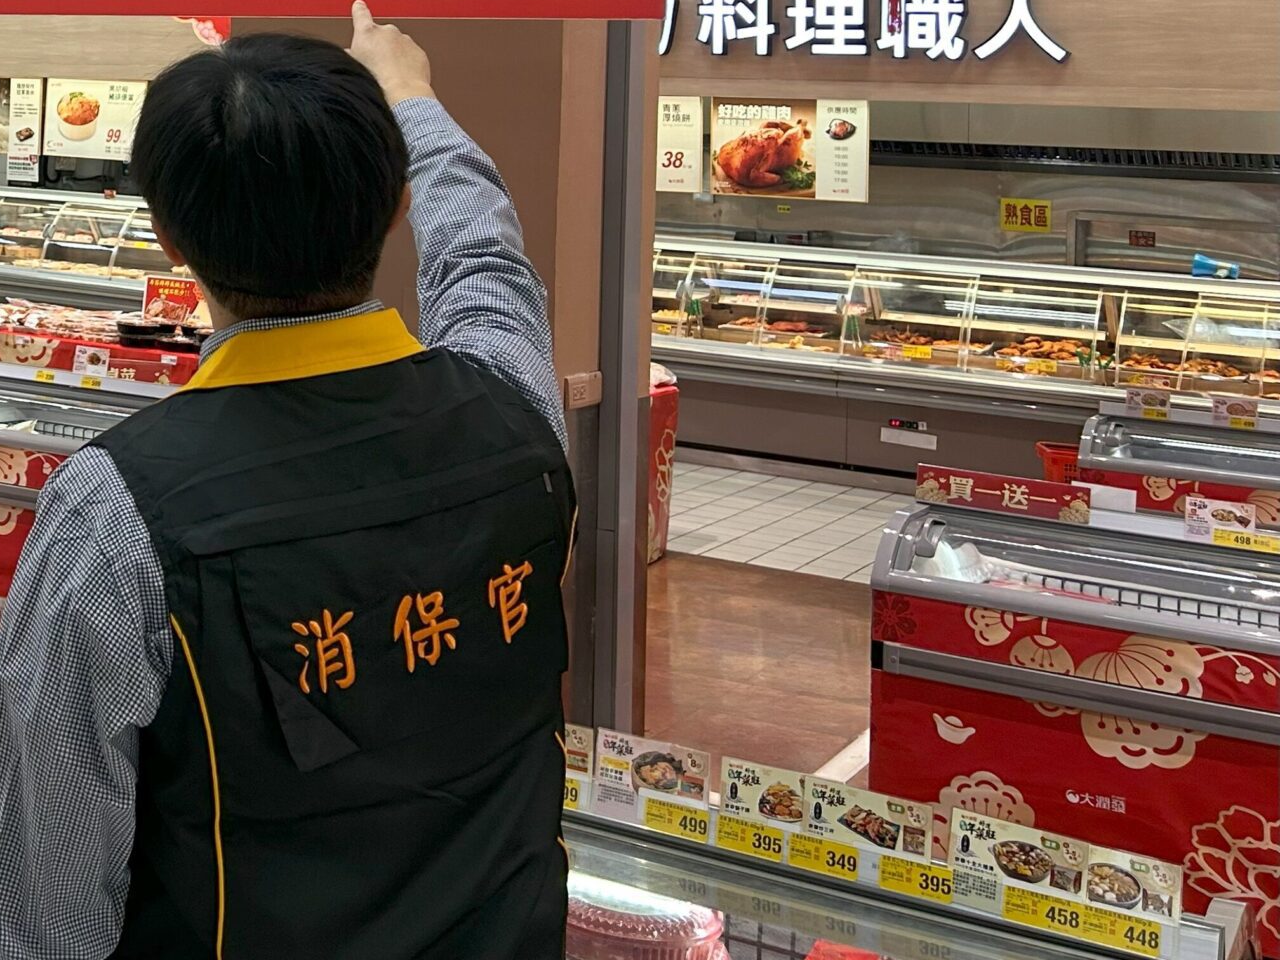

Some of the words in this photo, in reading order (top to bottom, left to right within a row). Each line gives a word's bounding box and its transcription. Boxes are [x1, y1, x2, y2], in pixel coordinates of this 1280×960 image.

[106, 129, 121, 143] 99
[661, 151, 684, 169] 38
[1004, 204, 1048, 227] 熟食區
[950, 475, 1057, 510] 買一送一
[291, 561, 534, 694] 消保官
[1080, 792, 1126, 814] 大潤發
[679, 815, 708, 836] 499
[752, 833, 782, 854] 395
[826, 850, 857, 872] 349
[919, 873, 951, 895] 395
[1045, 906, 1079, 929] 458
[1123, 926, 1159, 949] 448
